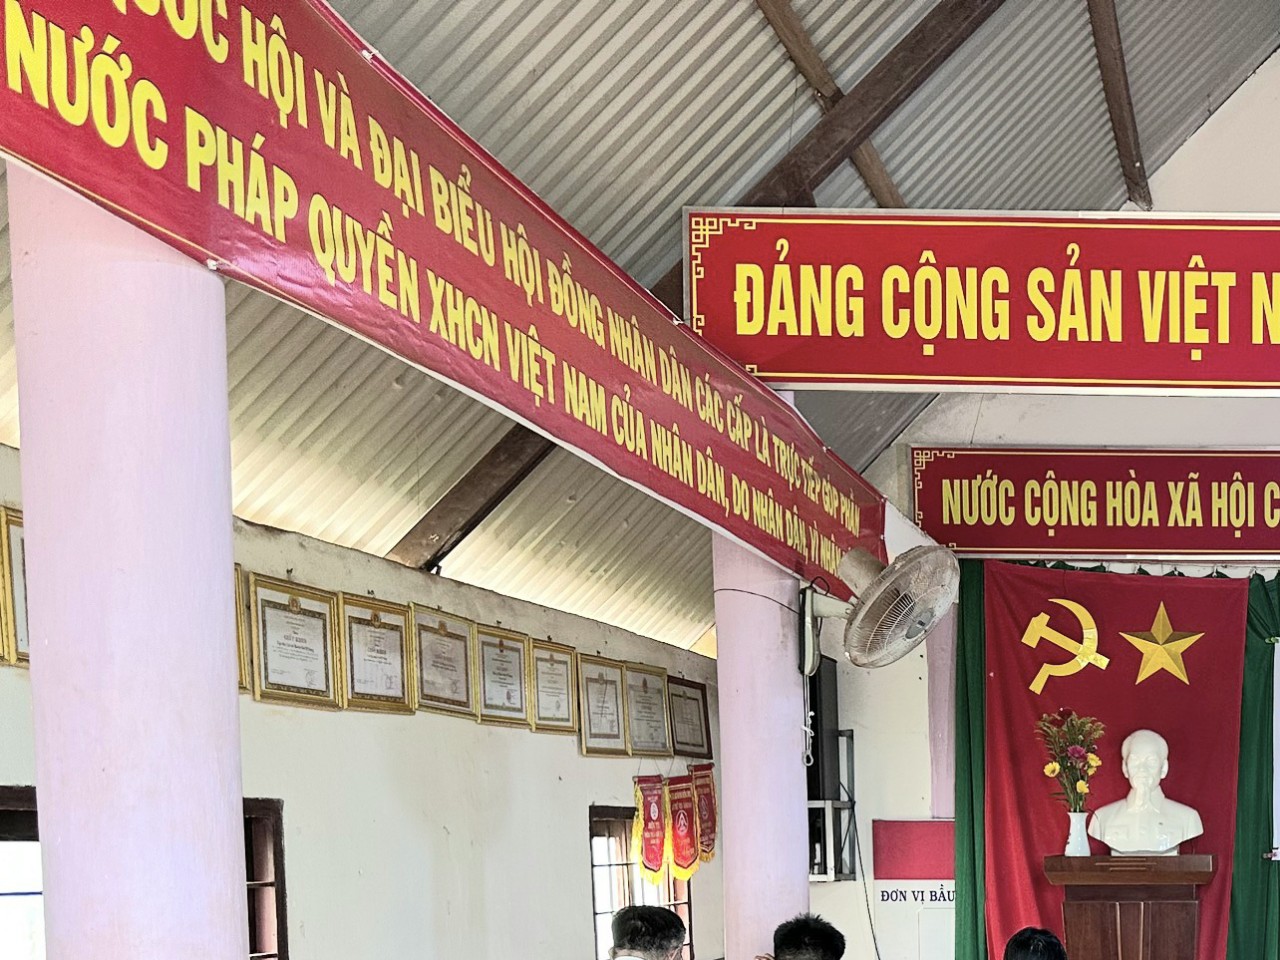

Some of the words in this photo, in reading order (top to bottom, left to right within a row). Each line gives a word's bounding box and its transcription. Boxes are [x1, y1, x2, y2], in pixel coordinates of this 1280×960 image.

[5, 0, 169, 171] NƯỚC
[185, 104, 299, 244] PHÁP
[308, 192, 421, 324] QUYỀN
[426, 268, 501, 372] XHCN
[504, 320, 557, 408] VIỆT
[562, 360, 608, 437] NAM
[611, 383, 648, 460] CỦA
[650, 418, 694, 488] NHÂN
[696, 446, 730, 518] DÂN,
[732, 473, 750, 521] DO
[752, 487, 784, 542] NHÂN
[241, 5, 308, 129] HỘI
[314, 68, 363, 171] VÀ
[368, 114, 426, 219] ĐẠI
[429, 163, 495, 267] BIỂU
[500, 222, 544, 307] HỘI
[546, 251, 606, 350] ĐỒNG
[607, 305, 658, 387] NHÂN
[659, 345, 694, 413] DÂN
[695, 373, 725, 434] CÁC
[727, 394, 753, 451] CẤP
[754, 416, 772, 468] LÀ
[772, 434, 802, 491] TRỰC
[801, 455, 821, 505] TIẾP
[822, 474, 839, 519] GÓP
[734, 238, 865, 338] ĐẢNG
[881, 250, 1011, 356] CỘNG
[1026, 243, 1124, 342] SẢN
[1139, 255, 1237, 361] VIỆT
[942, 469, 1016, 526] NƯỚC
[1024, 470, 1098, 537] CỘNG
[1106, 469, 1160, 527] HÒA
[1167, 472, 1203, 527] XÃ
[1212, 472, 1255, 538] HỘI
[880, 888, 908, 902] ĐƠN
[911, 890, 925, 905] VỊ
[929, 883, 955, 902] BẦU
